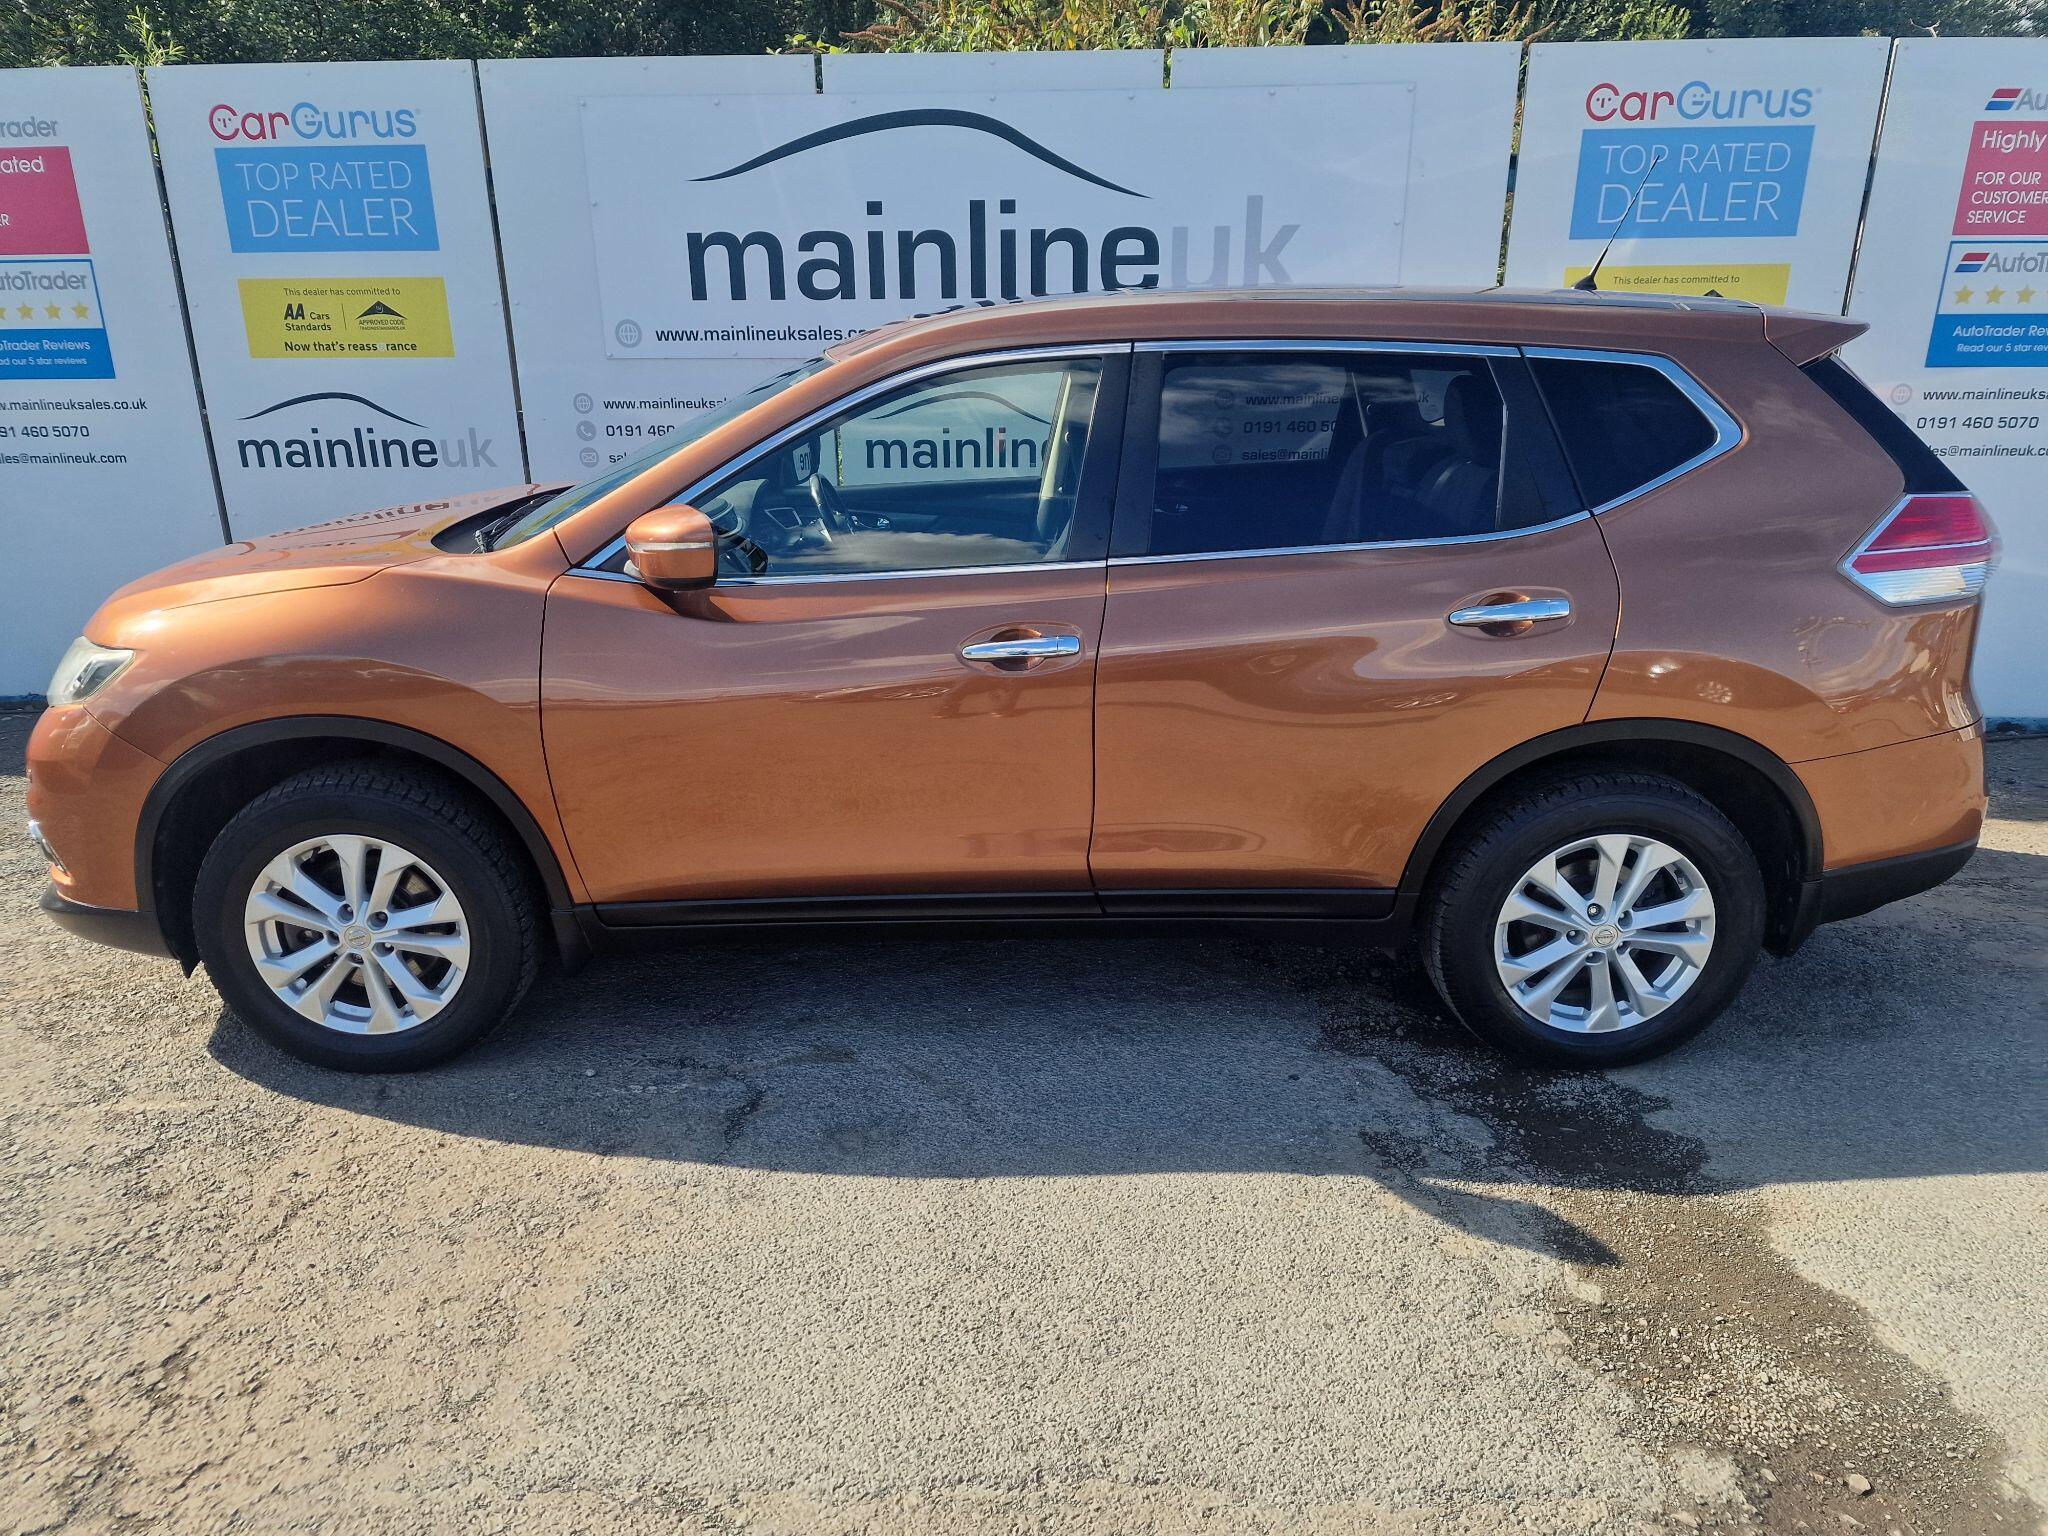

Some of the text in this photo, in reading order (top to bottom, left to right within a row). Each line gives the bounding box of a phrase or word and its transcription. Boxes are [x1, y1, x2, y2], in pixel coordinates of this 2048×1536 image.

[1585, 80, 1814, 122] CarGurus
[208, 101, 418, 141] CarGurus
[1981, 129, 2048, 153] Highly
[0, 155, 45, 173] ated
[1599, 142, 1792, 175] TOP RATED
[234, 160, 413, 191] TOP RATED
[1974, 171, 2042, 185] FOR OUR
[1596, 181, 1782, 224] DEALER
[1971, 191, 2048, 204] CUSTOMER
[246, 197, 419, 238] DEALER
[1966, 210, 2027, 224] SERVICE
[1983, 252, 2048, 273] AutoT
[1613, 274, 1740, 285] This dealer has committed to
[283, 286, 401, 296] This dealer has committed to
[284, 303, 331, 320] AA Cars
[285, 322, 332, 332] Standards
[1952, 325, 2026, 337] AutoTrader
[42, 339, 92, 351] Reviews
[284, 341, 311, 352] Now
[347, 342, 418, 352] reassrance
[1956, 343, 1985, 352] Read
[1986, 343, 2003, 352] our
[2004, 343, 2012, 352] 5
[2013, 343, 2032, 352] star
[11, 357, 27, 366] our
[28, 356, 35, 366] 5
[36, 356, 53, 366] star
[53, 356, 88, 366] reviews
[1243, 420, 1281, 433] 0191
[1286, 420, 1317, 433] 460
[1916, 416, 2040, 429] 0191 460 5070
[21, 425, 49, 437] 460
[52, 425, 90, 437] 5070
[606, 425, 642, 436] 0191
[237, 427, 499, 468] mainlineuk
[865, 427, 1050, 469] mainlin
[0, 452, 127, 464] les@mainlineuk.com
